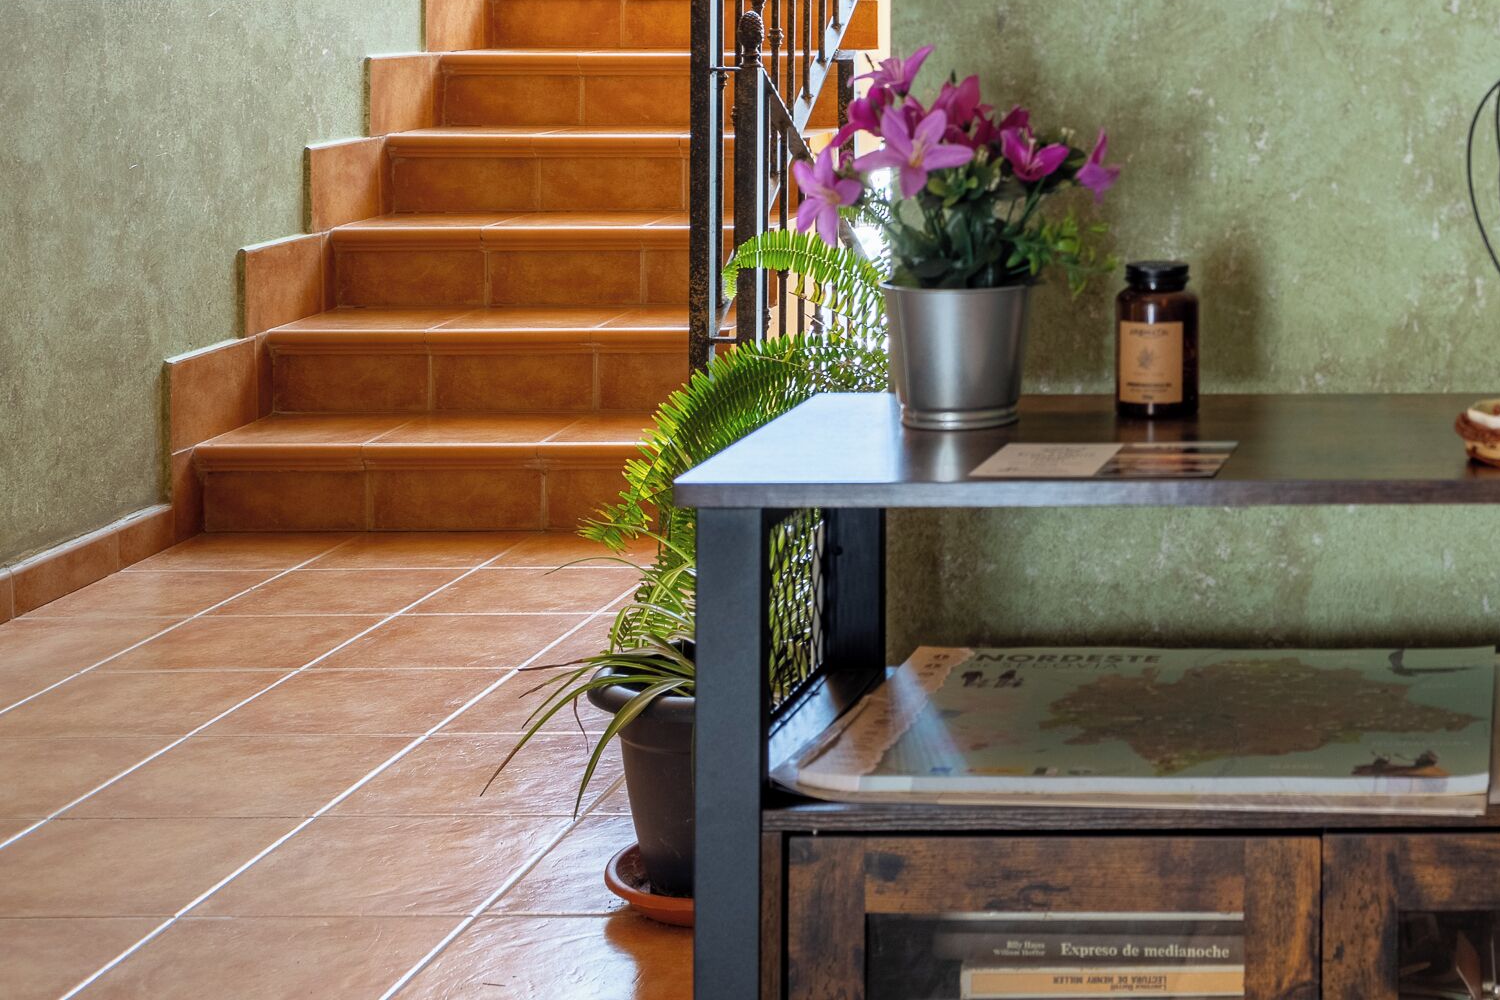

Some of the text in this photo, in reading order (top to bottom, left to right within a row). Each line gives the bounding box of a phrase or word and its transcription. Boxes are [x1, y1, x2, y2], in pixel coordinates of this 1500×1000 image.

[975, 654, 1162, 664] NORDESTE
[1003, 662, 1119, 670] SEGOVIA
[1060, 942, 1230, 959] Expreso de medianoche
[1053, 975, 1168, 985] LECTURA DE HENRY MILLER
